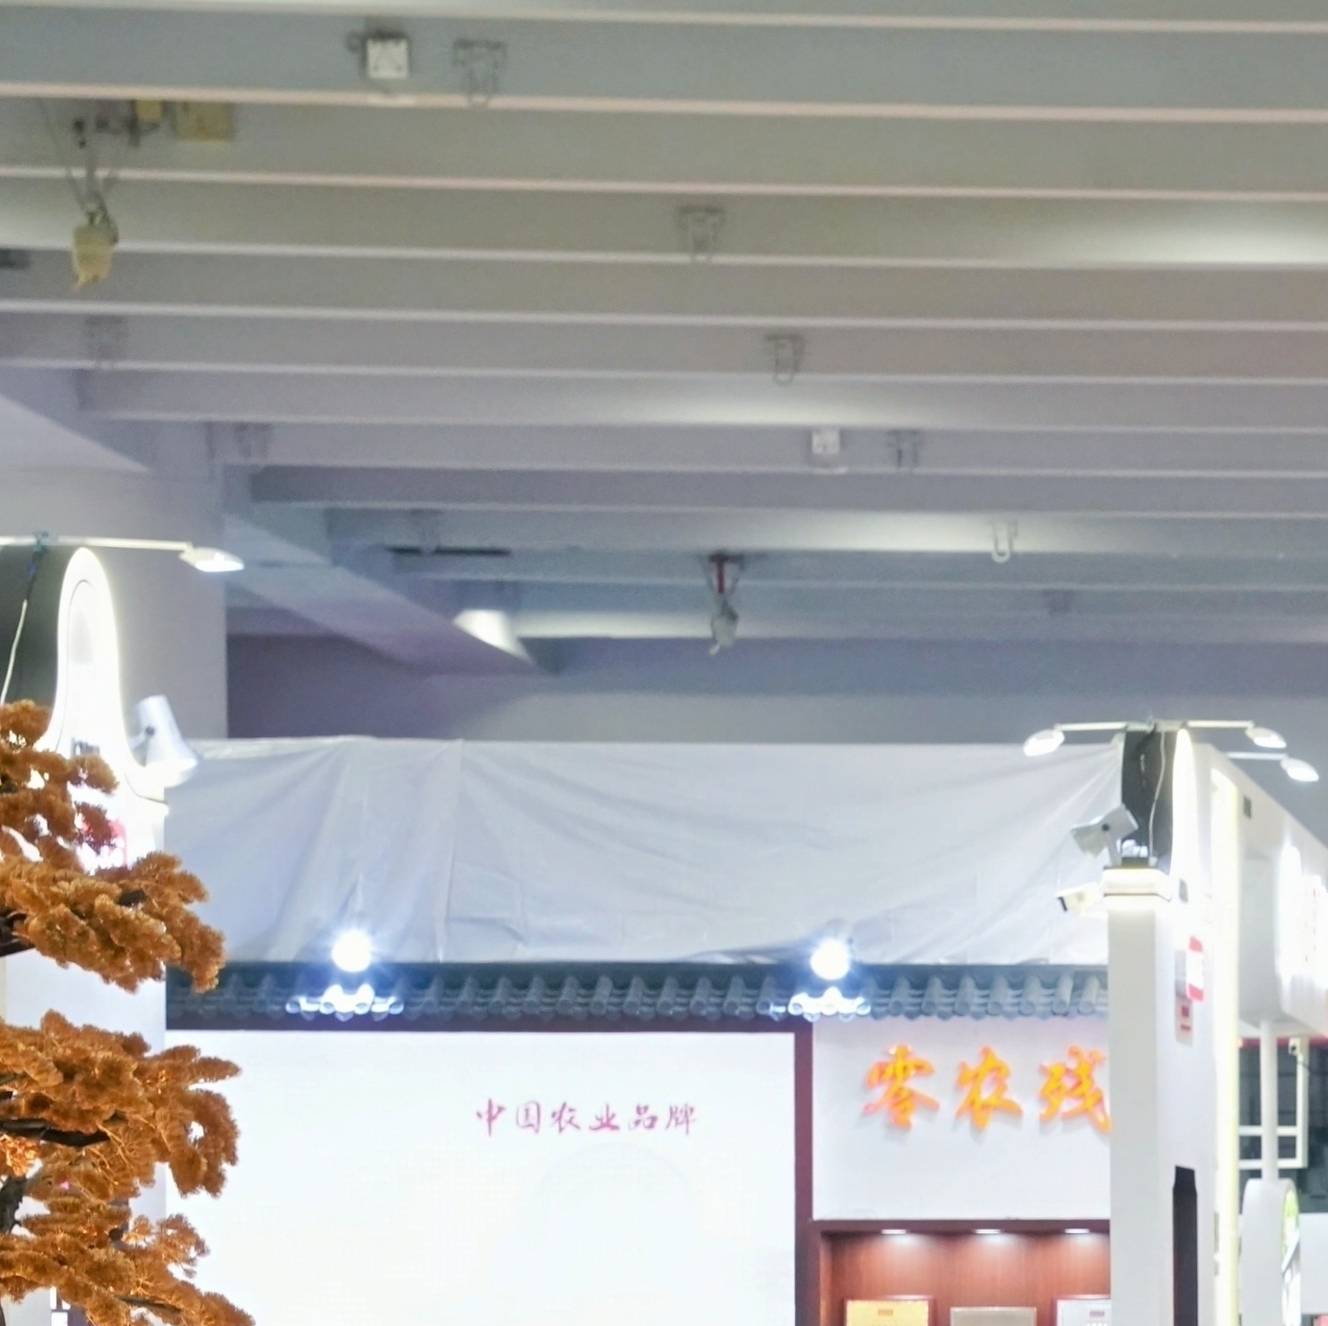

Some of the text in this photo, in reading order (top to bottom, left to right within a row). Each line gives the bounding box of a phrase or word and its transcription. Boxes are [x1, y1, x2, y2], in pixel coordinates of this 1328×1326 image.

[475, 1098, 698, 1138] 中国农业品牌
